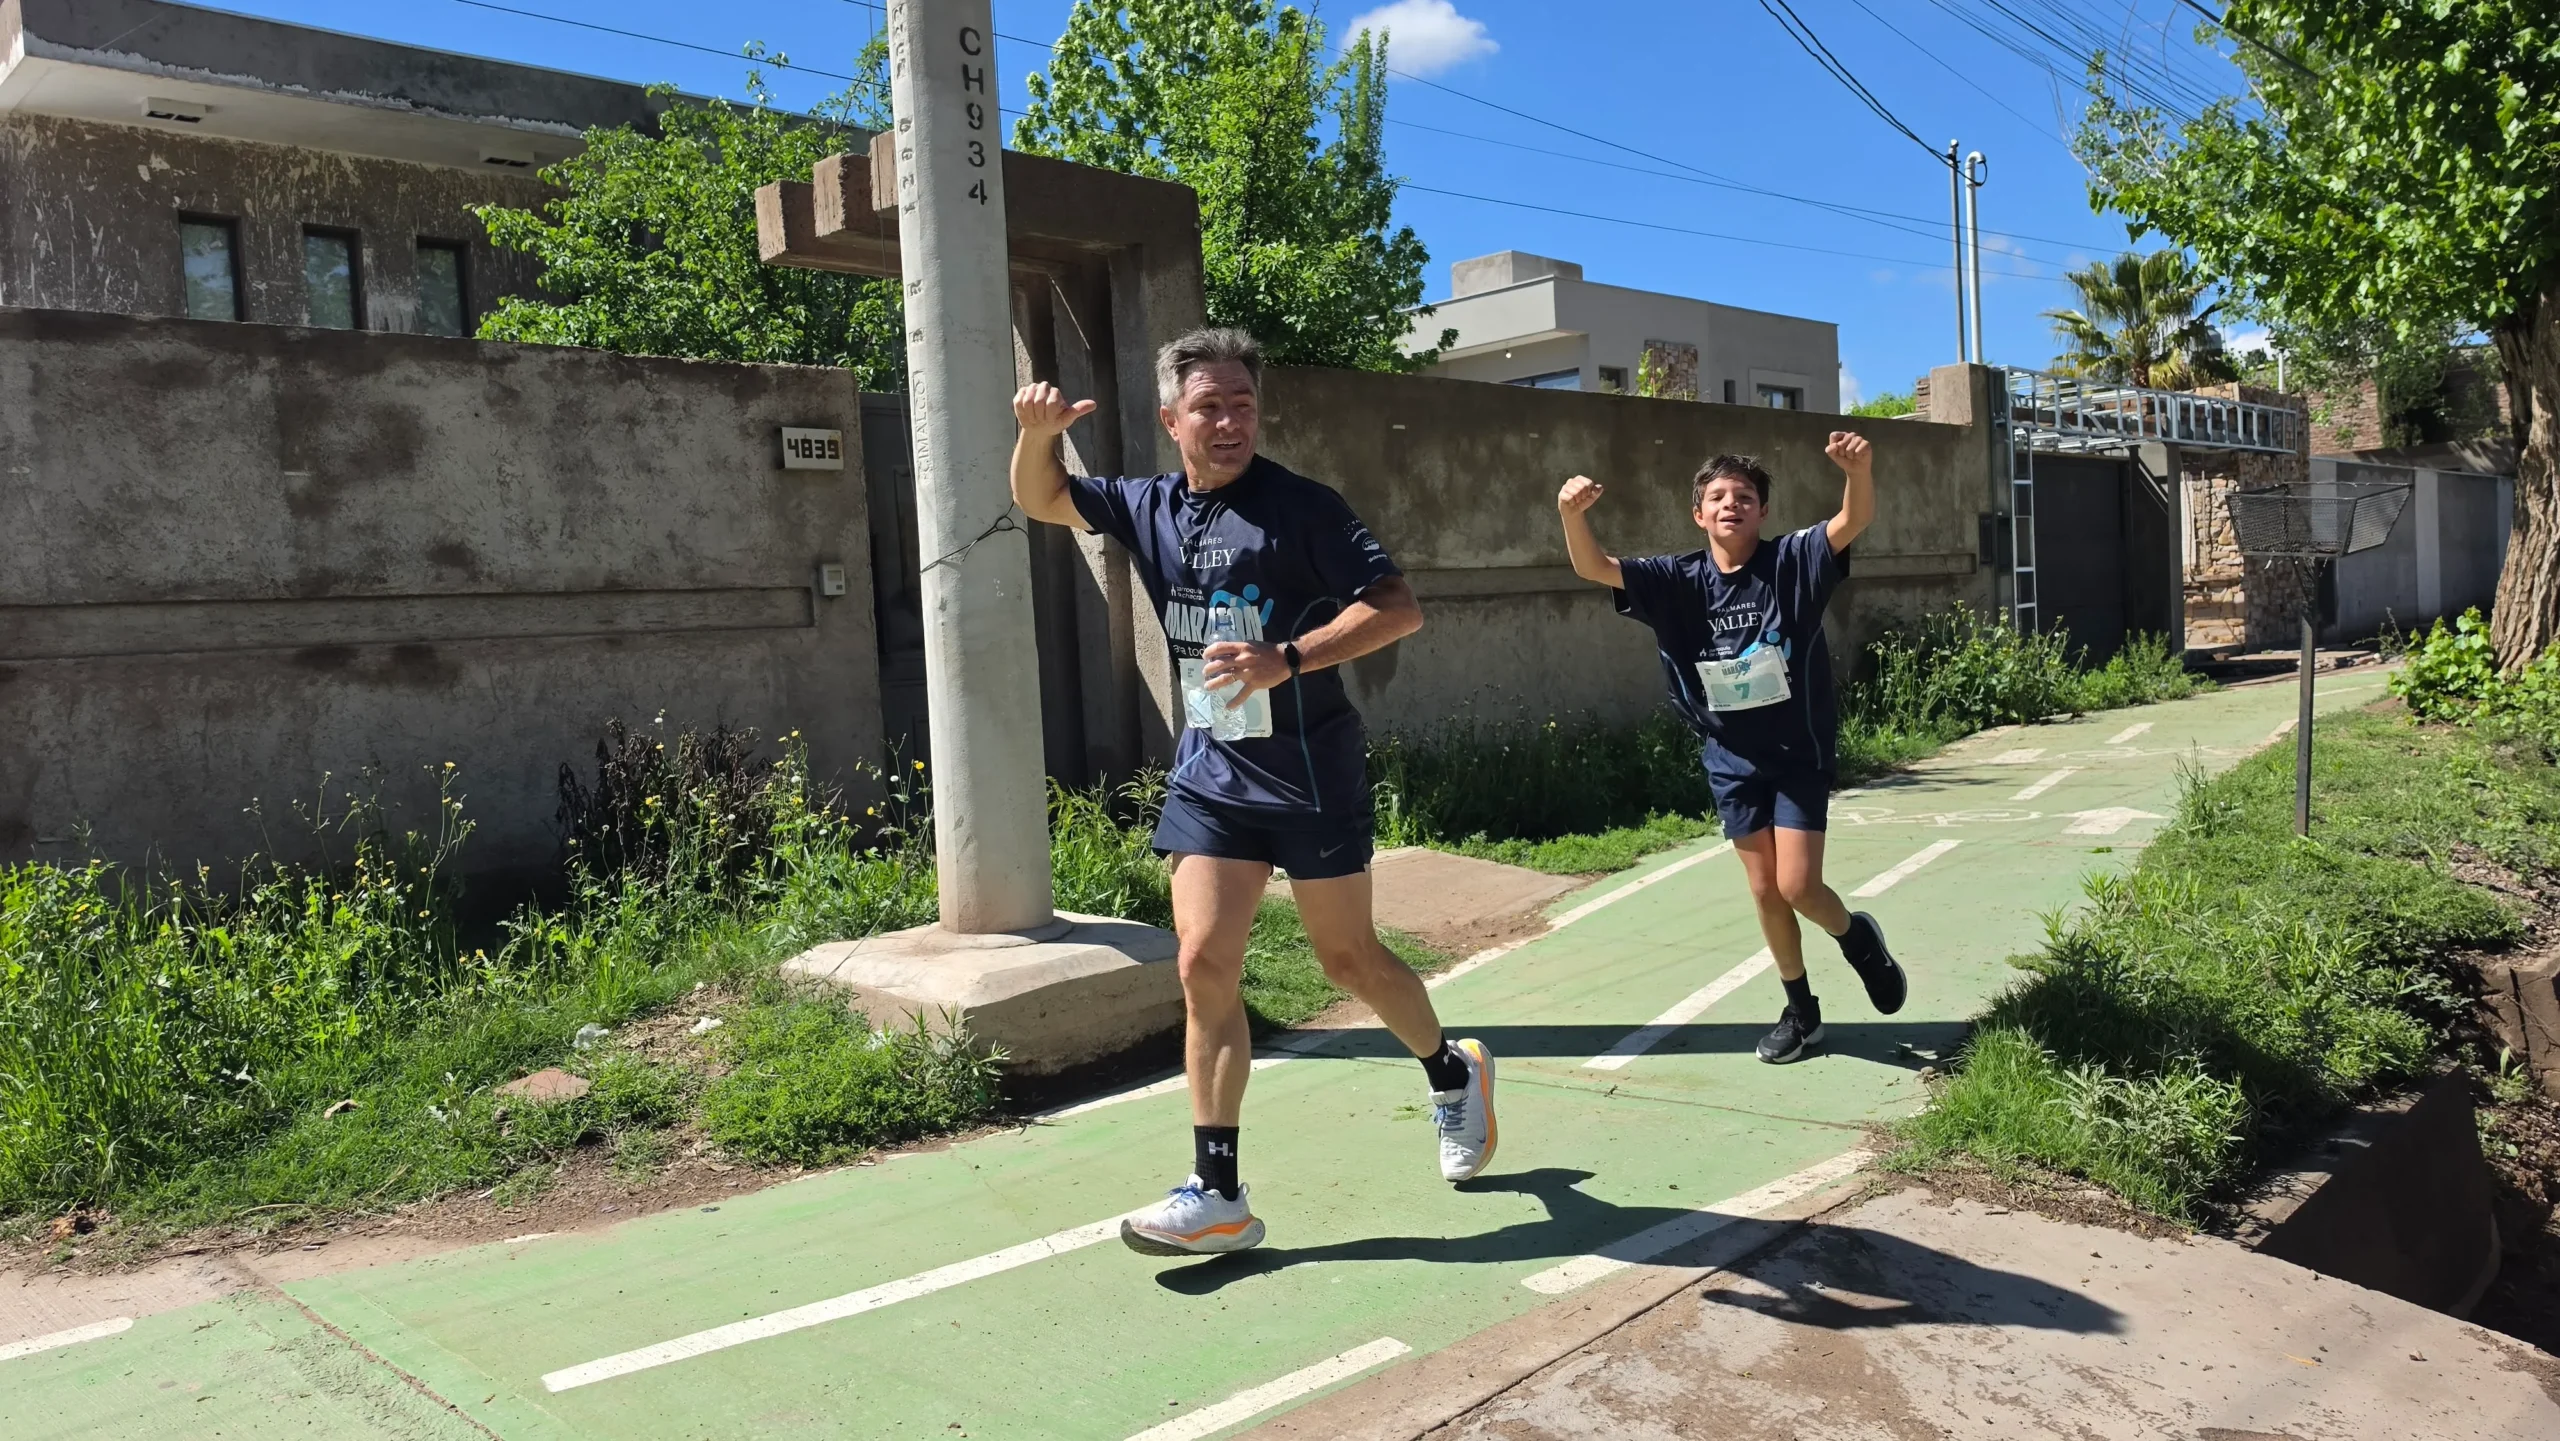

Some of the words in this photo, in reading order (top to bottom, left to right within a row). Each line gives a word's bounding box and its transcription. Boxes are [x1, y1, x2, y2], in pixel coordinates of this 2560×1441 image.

[959, 26, 988, 206] CH934
[787, 438, 840, 459] 4839
[1179, 547, 1236, 569] VLLEY
[1717, 602, 1756, 612] PALMARES
[1734, 682, 1750, 700] 7
[1208, 1141, 1234, 1157] H.
